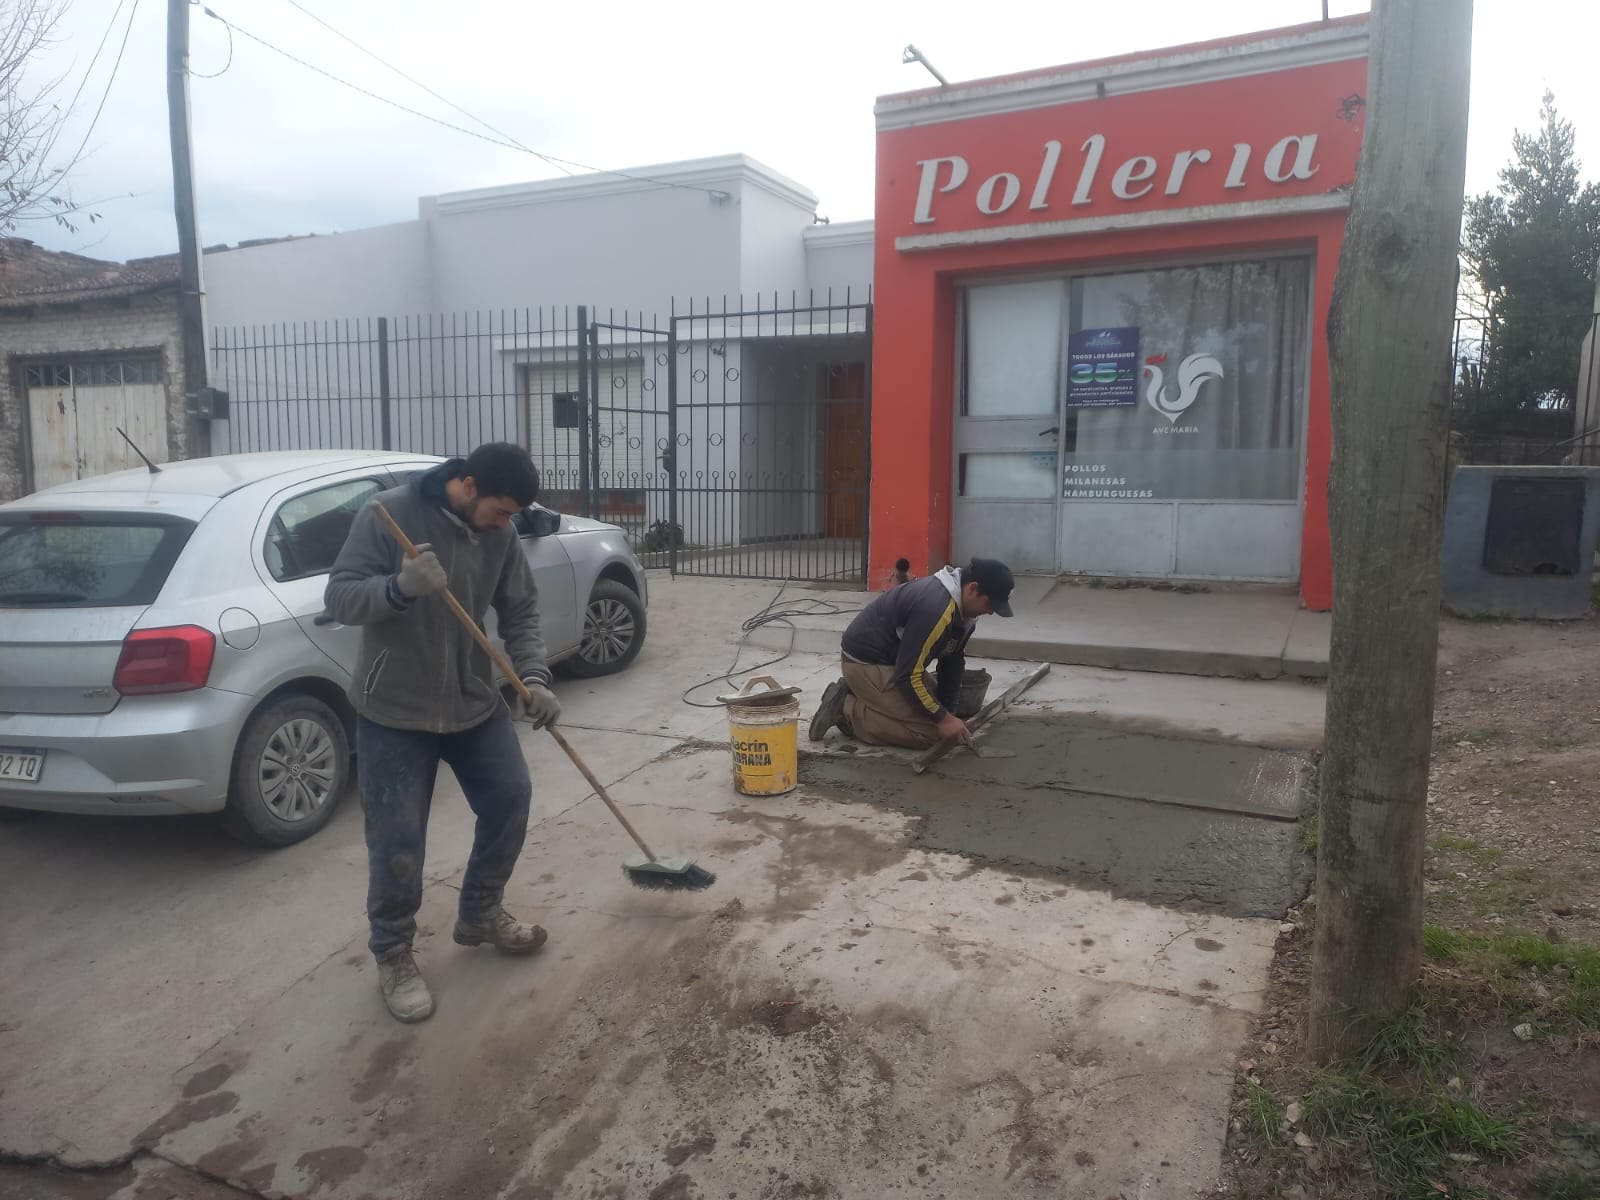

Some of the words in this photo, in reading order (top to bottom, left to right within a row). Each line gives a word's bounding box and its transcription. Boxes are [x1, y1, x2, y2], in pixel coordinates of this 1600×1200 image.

[1152, 426, 1169, 434] AVE
[1064, 477, 1126, 485] MILANESAS
[1063, 490, 1153, 498] HAMBURGUESAS
[18, 756, 37, 777] TQ
